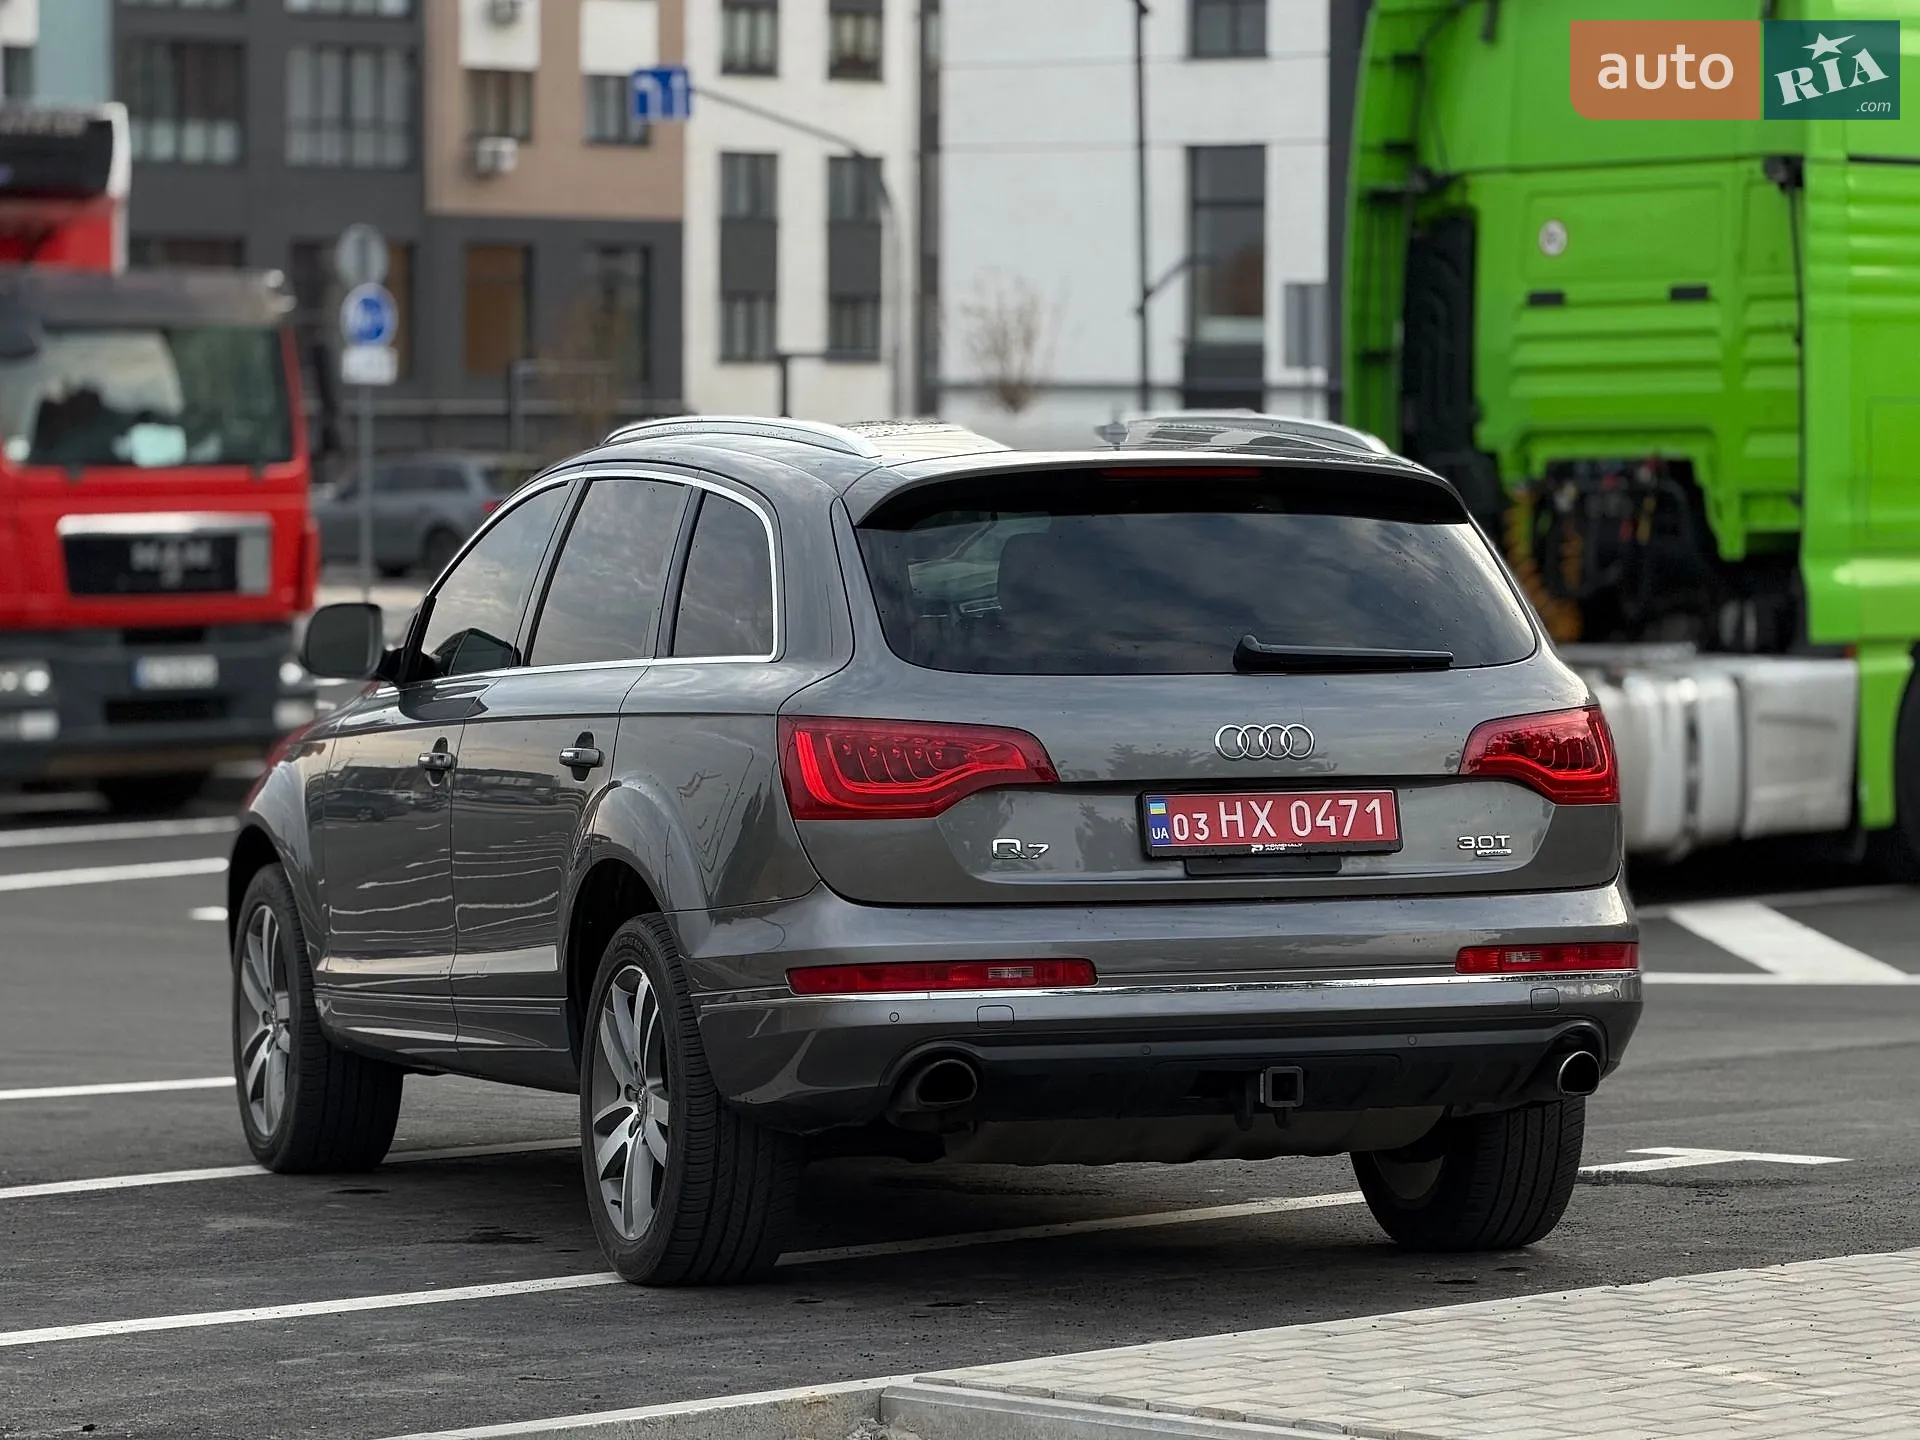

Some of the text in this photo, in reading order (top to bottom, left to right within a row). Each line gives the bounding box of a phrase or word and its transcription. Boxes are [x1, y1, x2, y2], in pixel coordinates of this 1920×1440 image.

[1152, 798, 1384, 841] UA 03 HX 0471
[992, 838, 1049, 859] Q7
